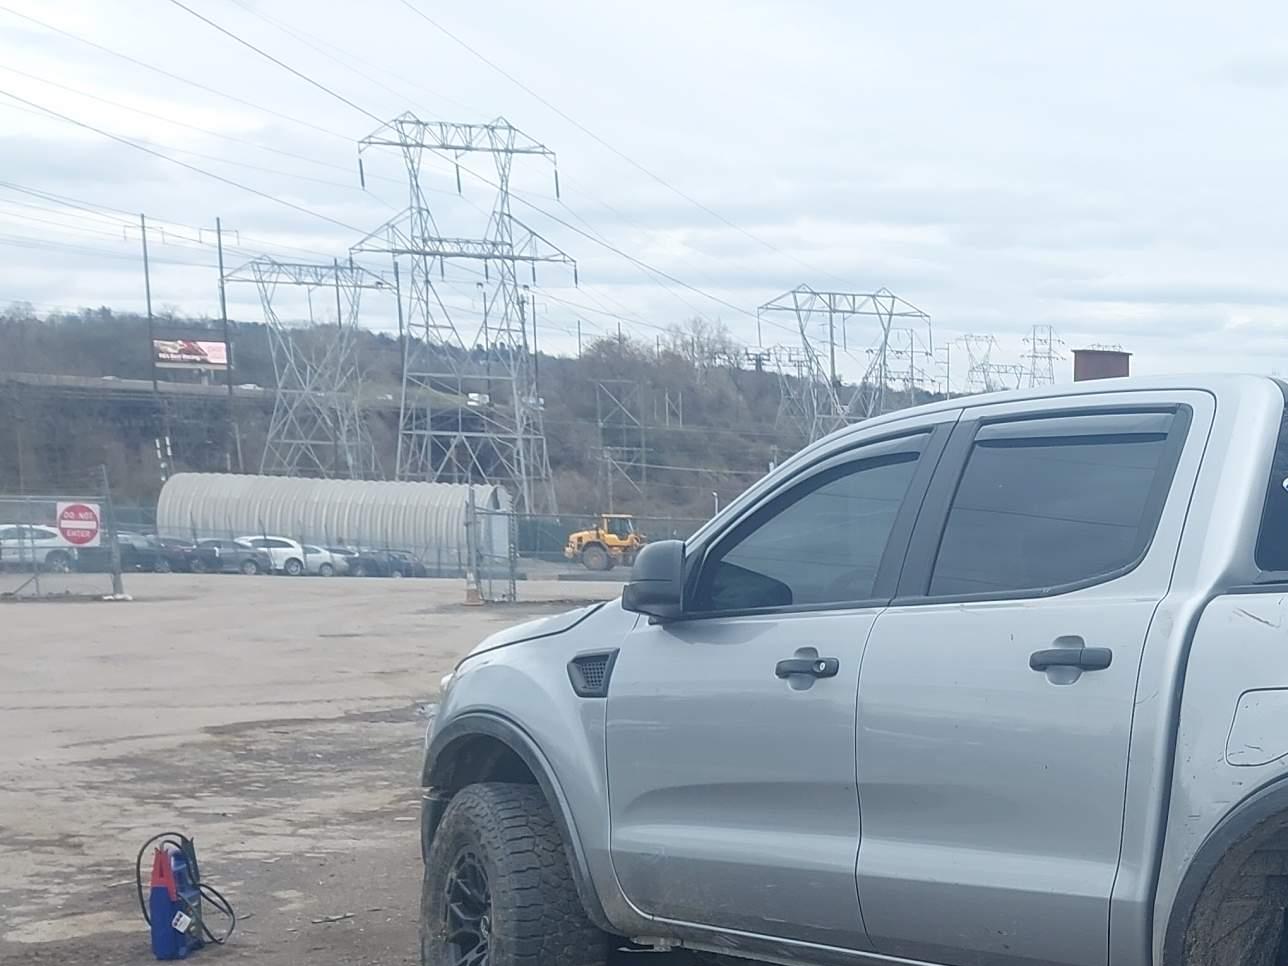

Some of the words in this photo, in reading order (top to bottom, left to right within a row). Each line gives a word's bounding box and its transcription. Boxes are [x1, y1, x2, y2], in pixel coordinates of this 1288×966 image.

[63, 511, 75, 519] DO
[78, 511, 94, 519] NOT
[66, 529, 91, 537] ENTER
